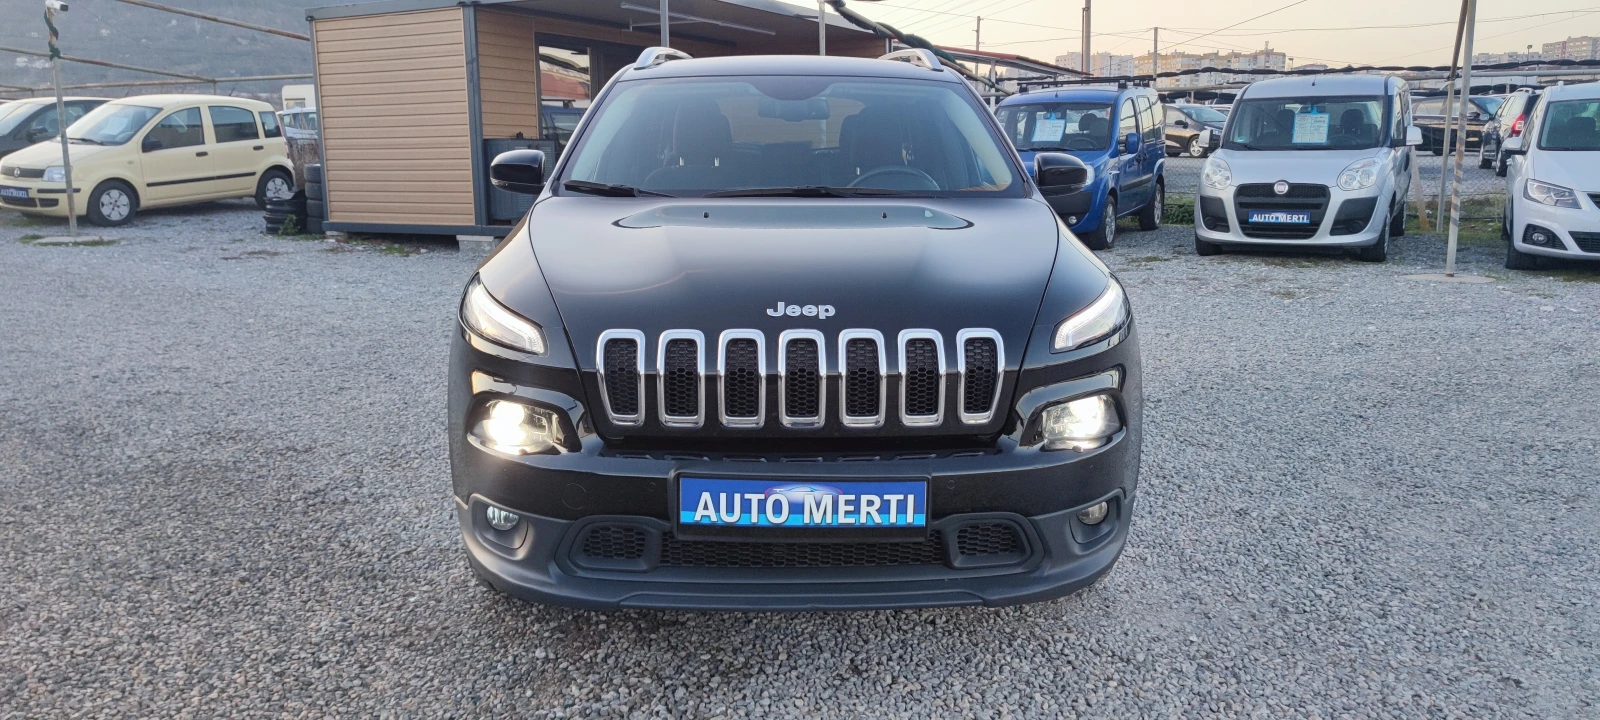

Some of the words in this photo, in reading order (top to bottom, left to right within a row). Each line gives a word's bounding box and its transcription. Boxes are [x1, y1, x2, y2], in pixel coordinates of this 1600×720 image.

[1252, 213, 1276, 222] AUTO
[1278, 214, 1307, 222] MERTI
[766, 301, 836, 320] Jeep
[693, 491, 790, 524] AUTO
[803, 494, 915, 525] MERTI
